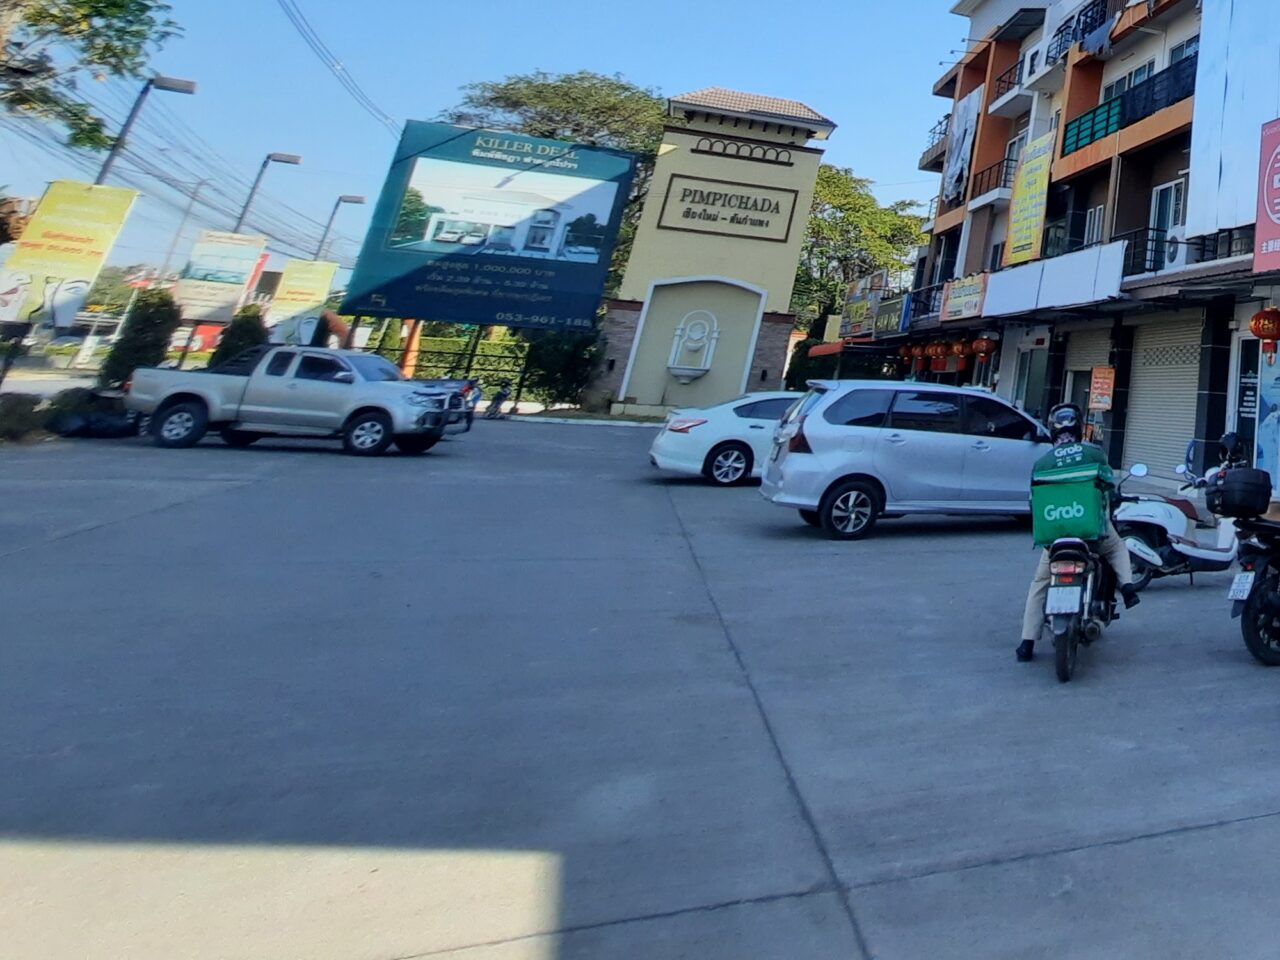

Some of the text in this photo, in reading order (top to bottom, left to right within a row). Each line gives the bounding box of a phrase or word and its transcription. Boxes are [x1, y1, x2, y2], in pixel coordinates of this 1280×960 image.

[475, 136, 580, 159] KILLER DEAL
[680, 188, 781, 215] PIMPICHADA
[1054, 444, 1083, 458] Grab
[1044, 501, 1085, 521] Grab
